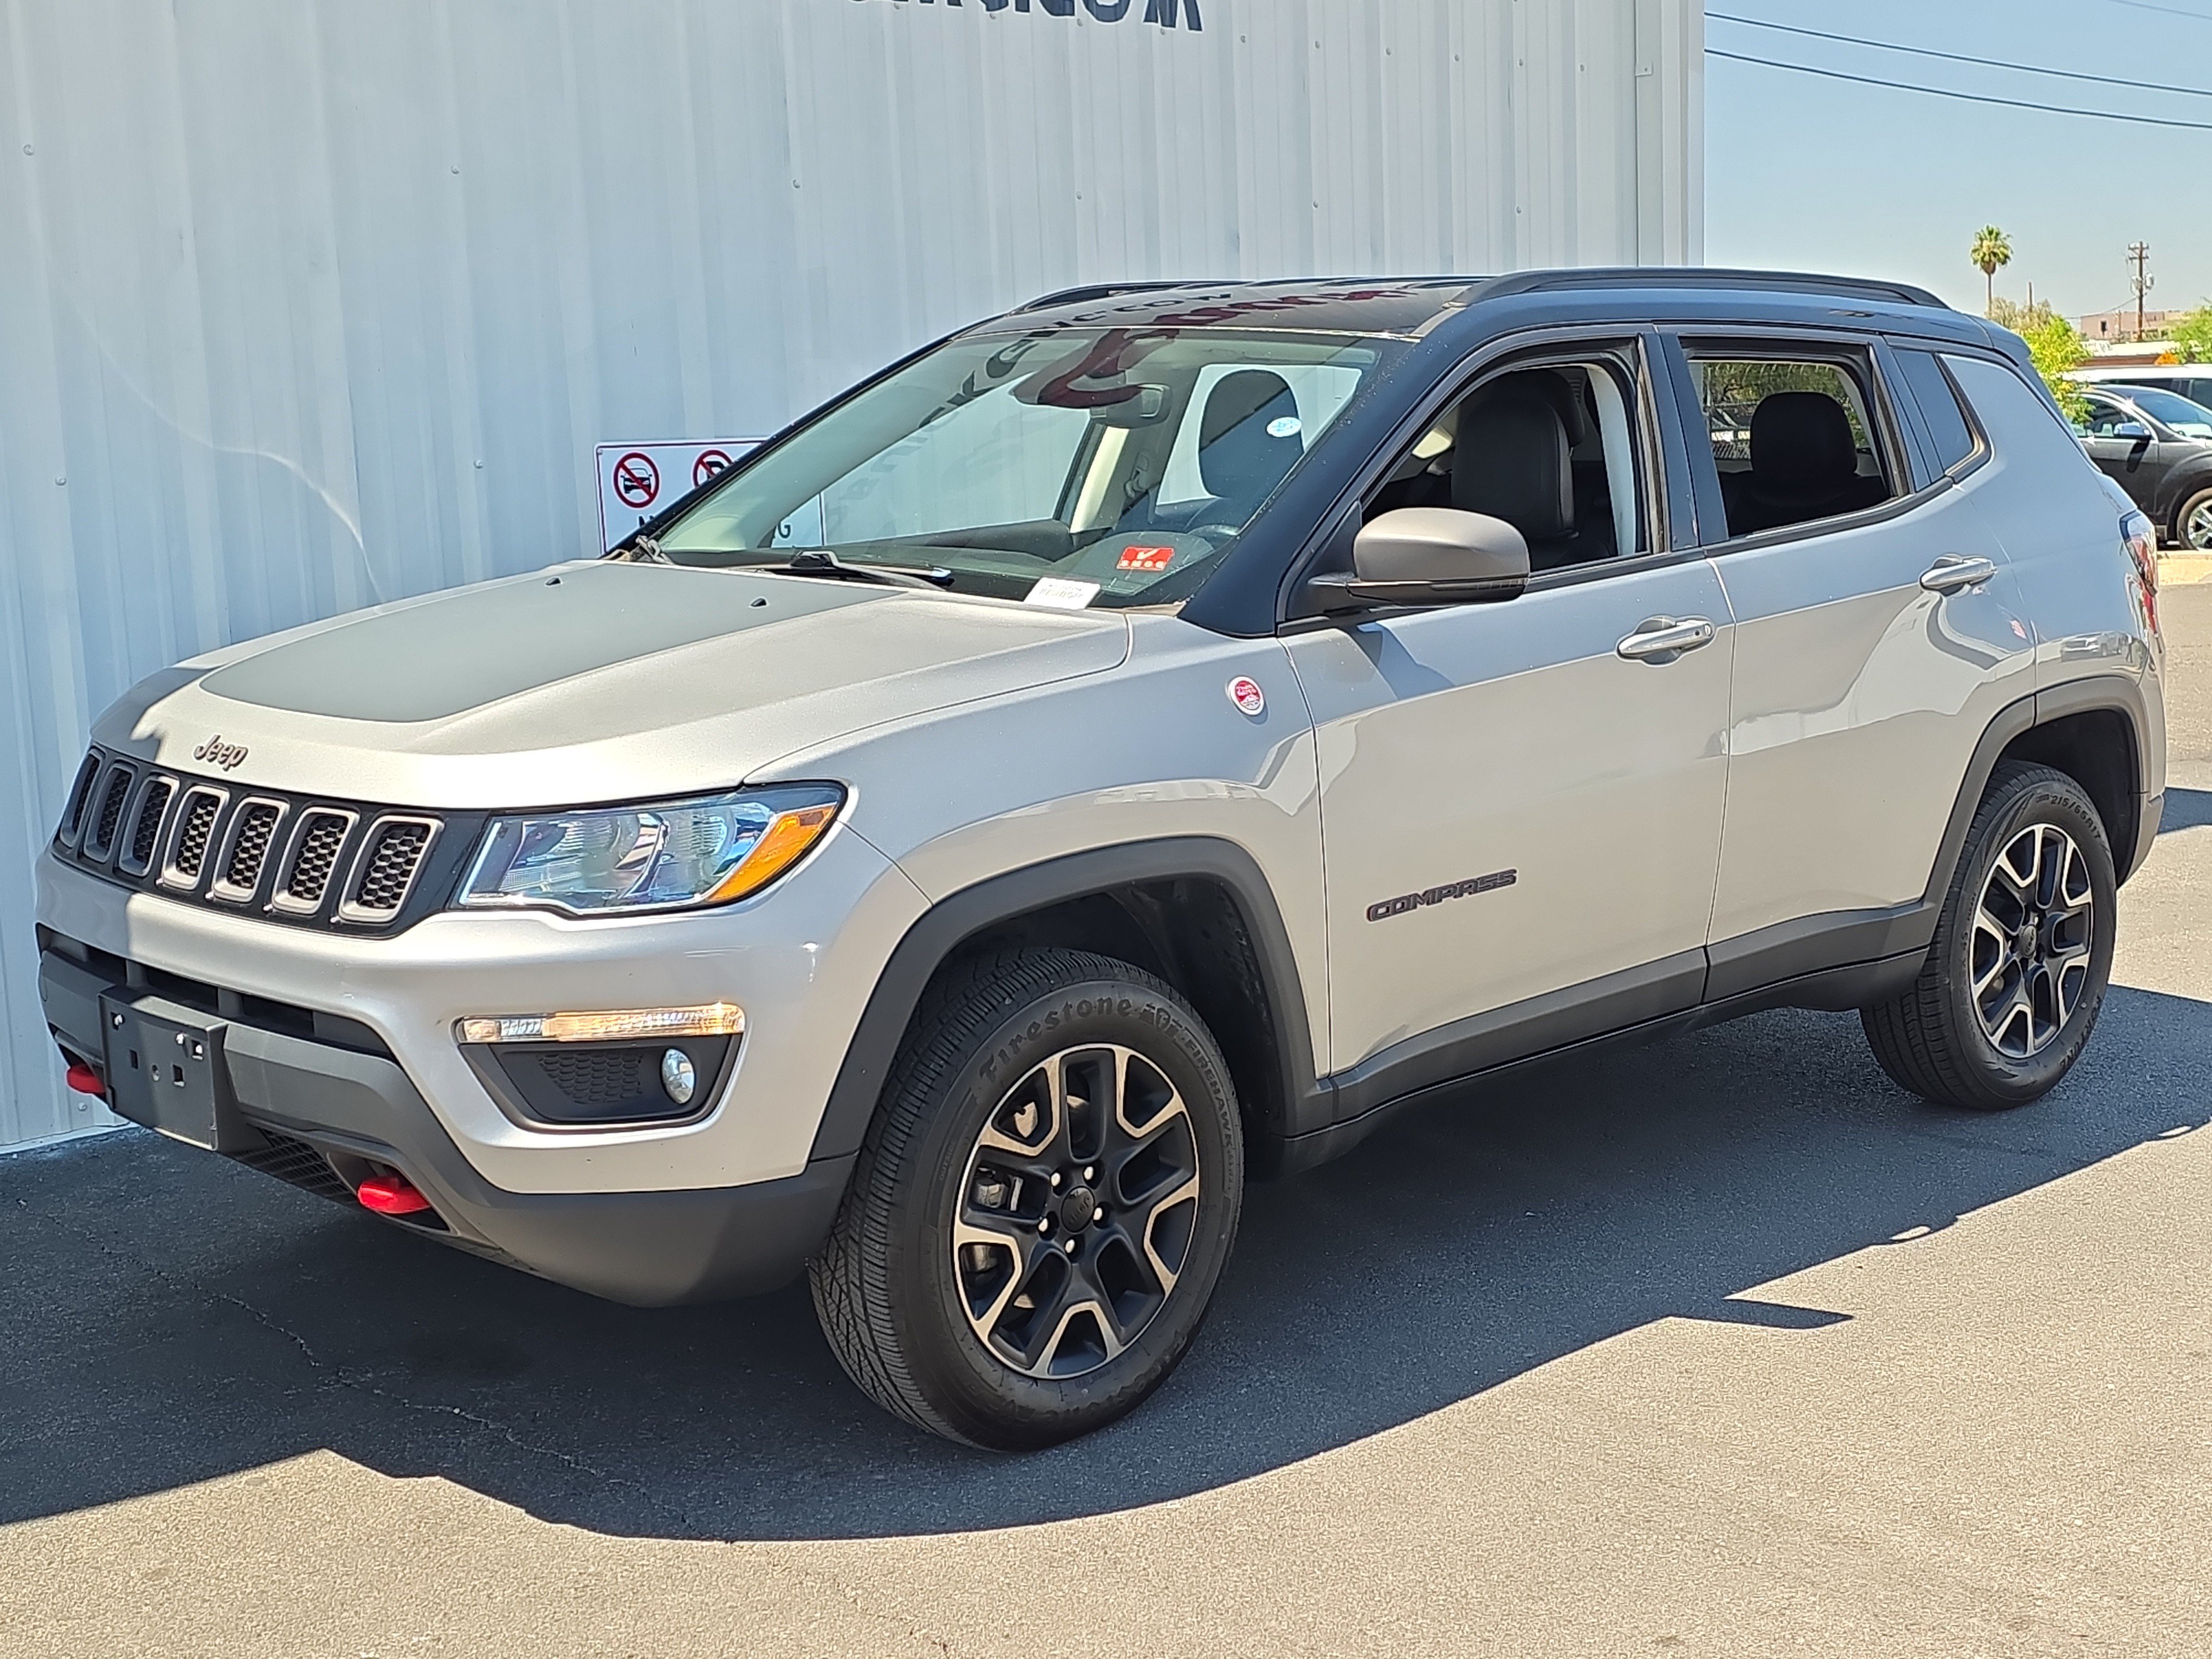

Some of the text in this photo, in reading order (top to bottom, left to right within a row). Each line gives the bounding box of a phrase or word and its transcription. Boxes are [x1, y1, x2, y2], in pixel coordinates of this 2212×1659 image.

[194, 735, 248, 771] Jeep
[1366, 869, 1517, 922] COMPASS
[979, 995, 1131, 1083] Firestone
[1185, 1038, 1233, 1148] FIREHAWK
